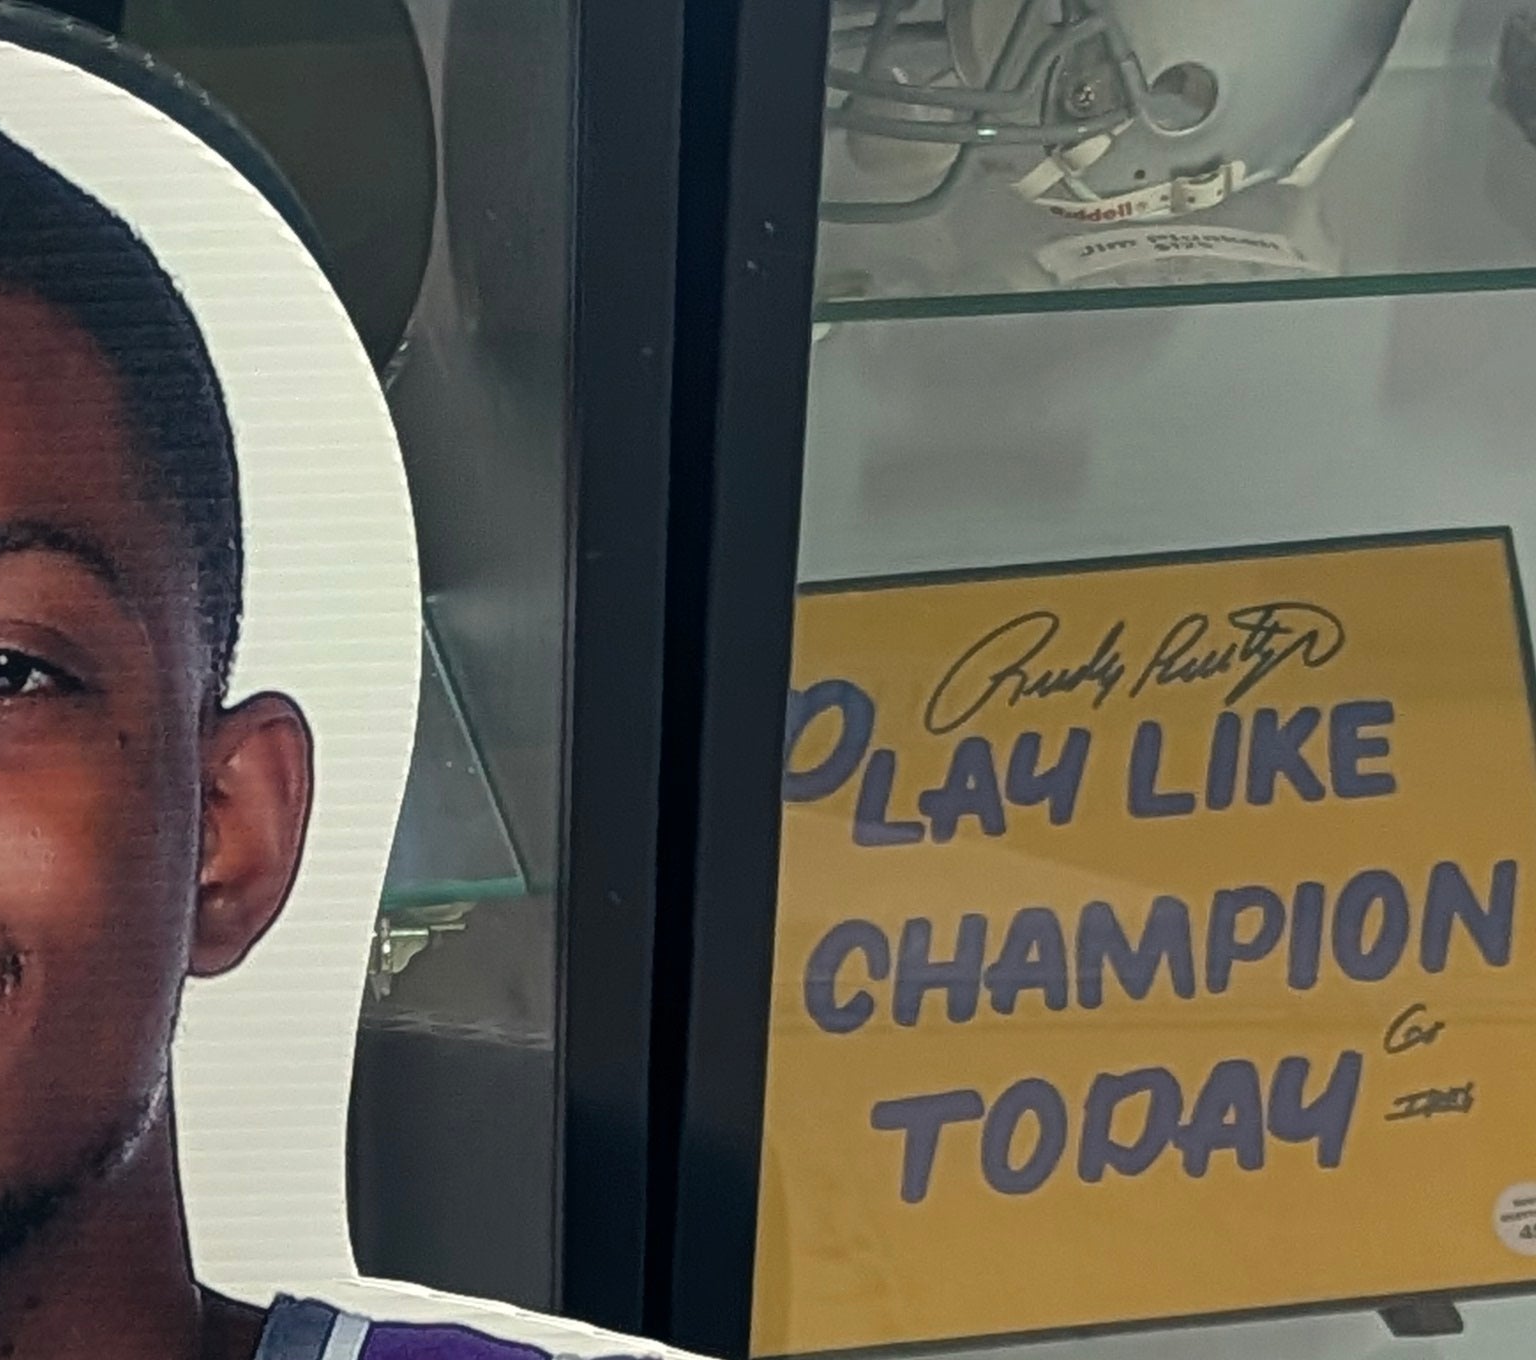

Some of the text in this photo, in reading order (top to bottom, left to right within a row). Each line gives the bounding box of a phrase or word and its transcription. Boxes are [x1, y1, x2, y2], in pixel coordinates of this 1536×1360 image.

[1126, 700, 1398, 820] LIKE
[802, 858, 1519, 1035] CHAMPION
[870, 1050, 1363, 1205] TODAY
